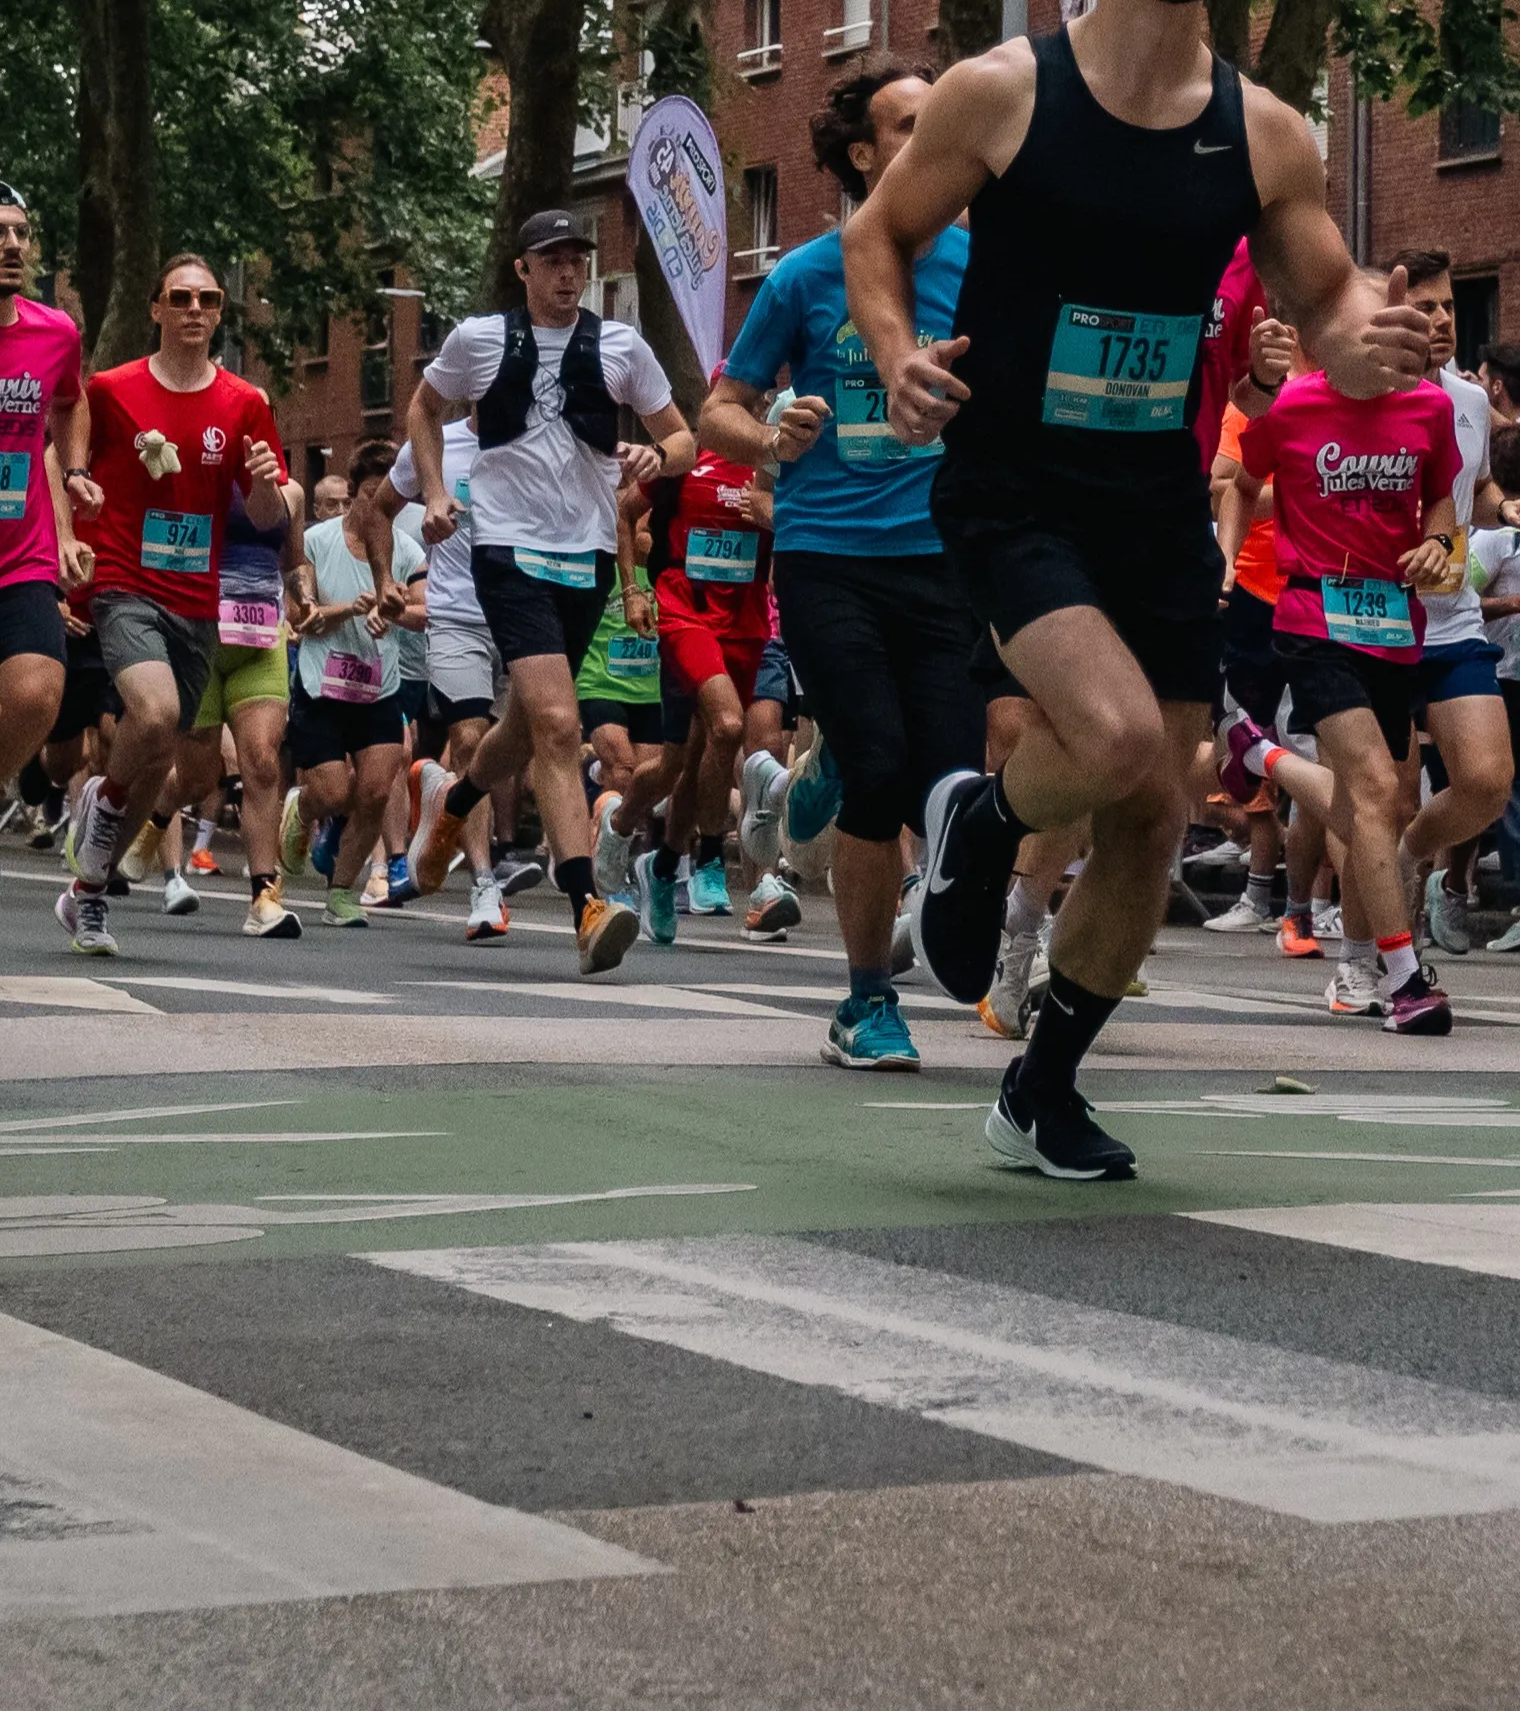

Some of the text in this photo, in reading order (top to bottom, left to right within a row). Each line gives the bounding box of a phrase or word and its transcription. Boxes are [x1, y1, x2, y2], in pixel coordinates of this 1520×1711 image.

[1098, 335, 1170, 381] 1735
[1105, 382, 1151, 398] DONOVAN
[1316, 442, 1418, 477] Courir
[1319, 473, 1415, 497] Jules Verne
[167, 523, 198, 547] 974
[704, 538, 742, 559] 2794
[233, 605, 264, 626] 3303
[1344, 591, 1387, 618] 1239
[621, 643, 652, 659] 2240
